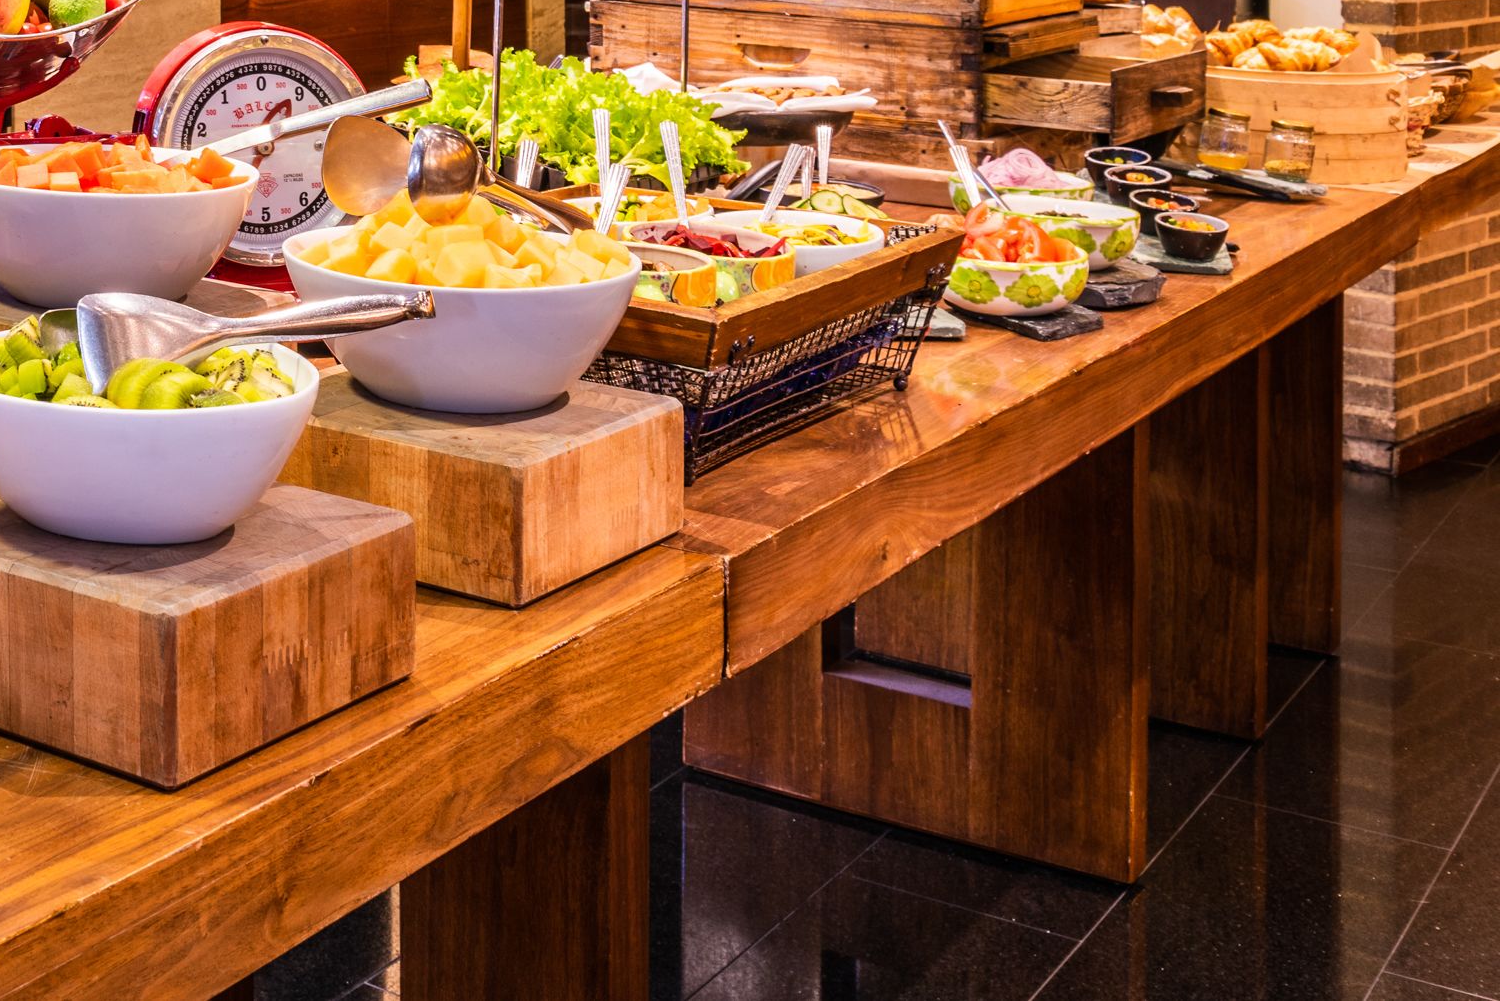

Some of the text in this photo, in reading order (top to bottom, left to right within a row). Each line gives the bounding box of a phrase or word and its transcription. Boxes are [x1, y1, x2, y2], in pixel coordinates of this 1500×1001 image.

[256, 76, 266, 91] 0
[221, 89, 229, 104] 1
[294, 86, 304, 102] 9
[197, 122, 207, 137] 2
[299, 191, 309, 206] 6
[261, 206, 271, 222] 5
